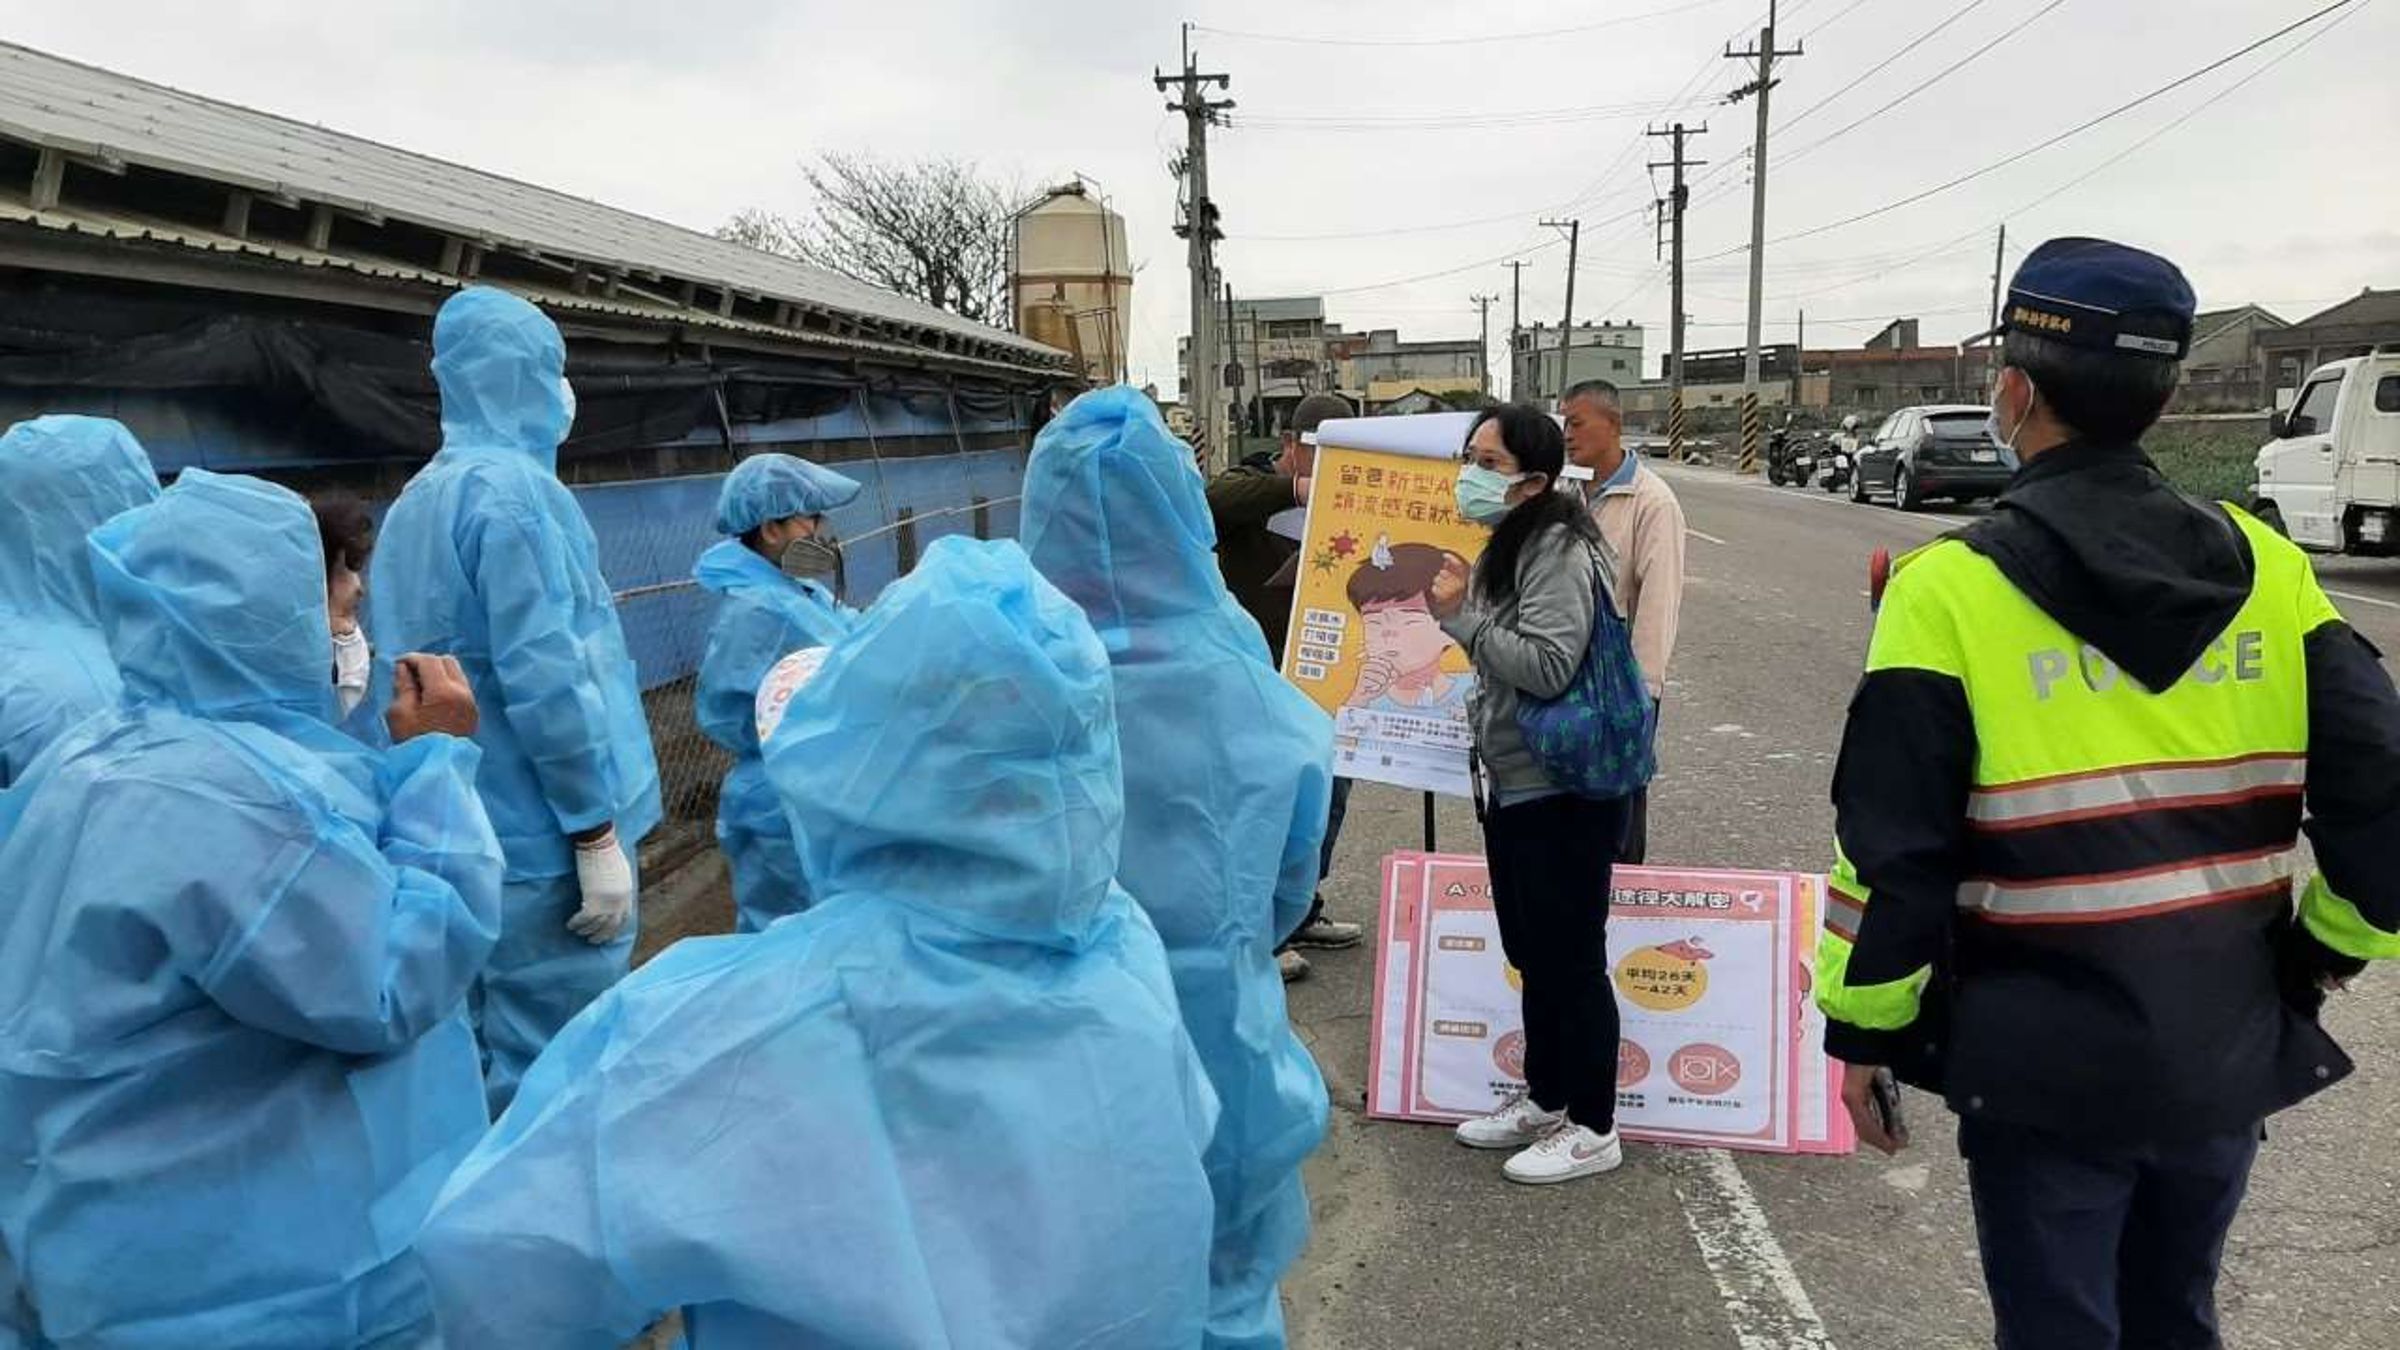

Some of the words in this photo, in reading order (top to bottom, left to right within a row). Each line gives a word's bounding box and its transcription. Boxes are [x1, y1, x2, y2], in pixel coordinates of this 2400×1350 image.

[1339, 463, 1451, 496] 留意新型A
[1332, 491, 1477, 526] 類流感症狀
[2028, 630, 2263, 701] POCE
[1626, 966, 1697, 982] 平均26天
